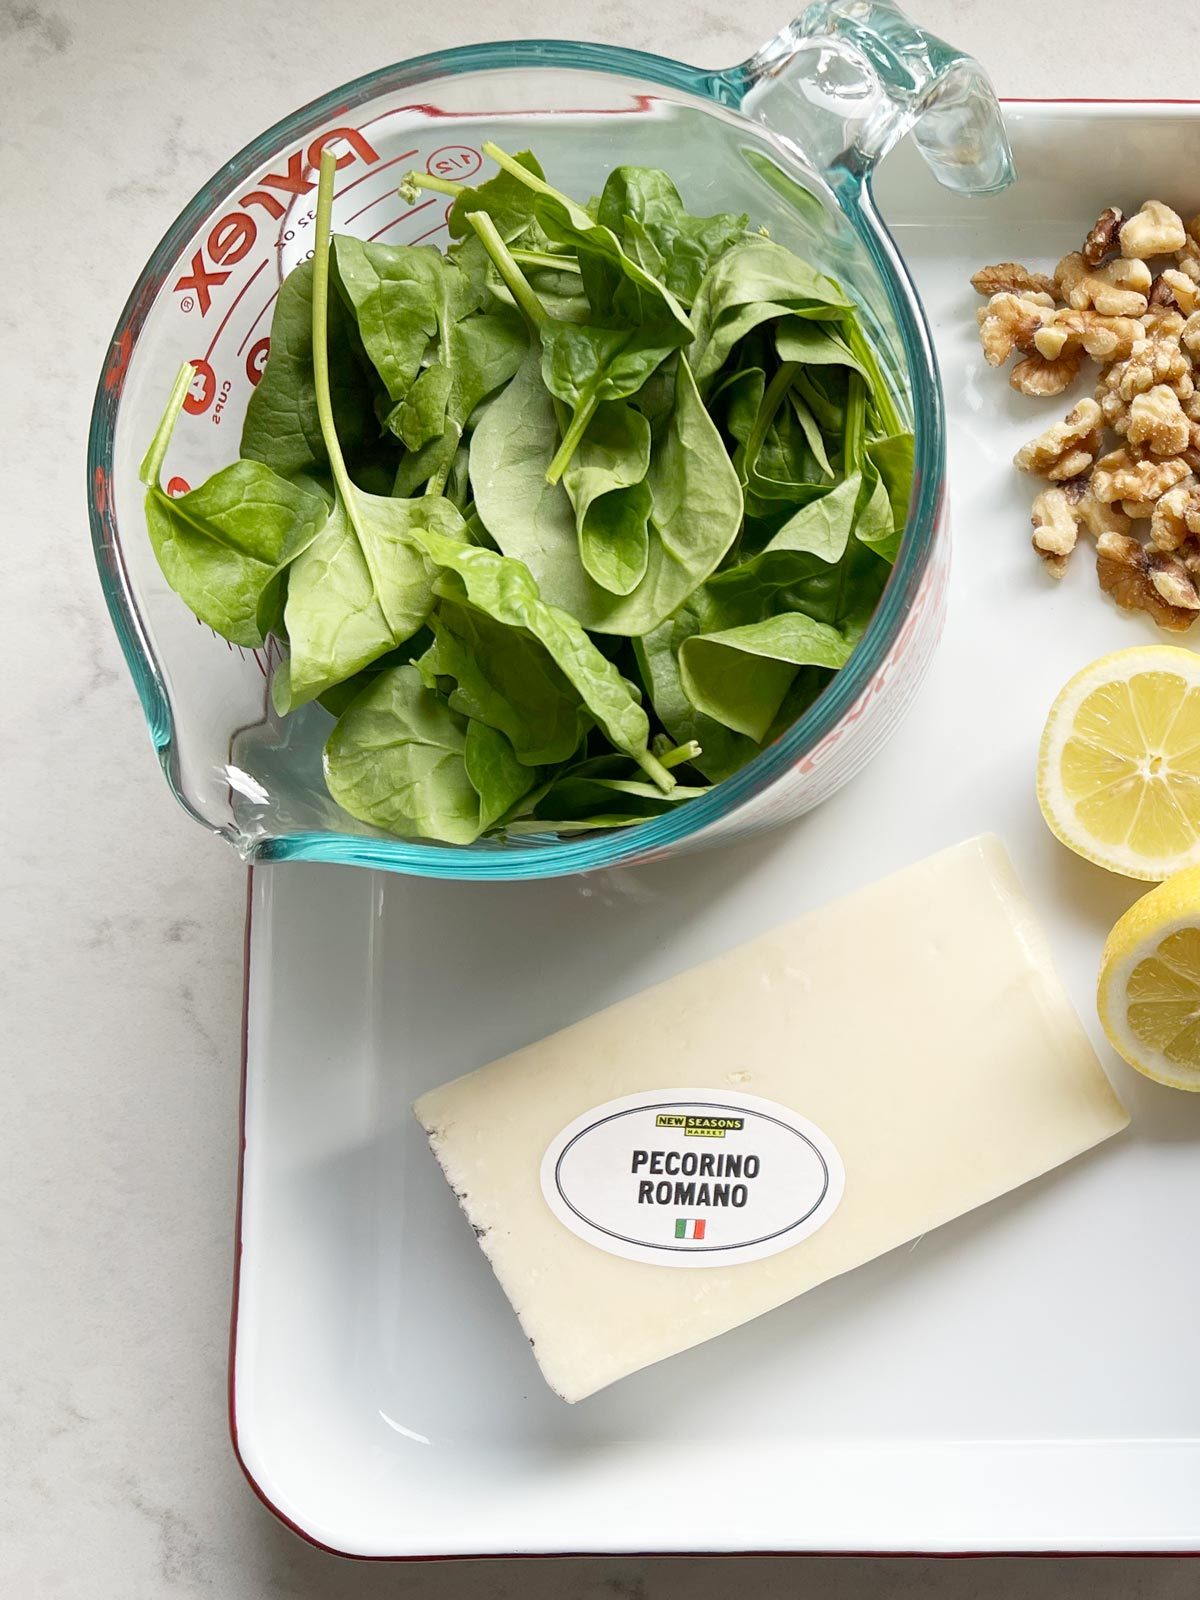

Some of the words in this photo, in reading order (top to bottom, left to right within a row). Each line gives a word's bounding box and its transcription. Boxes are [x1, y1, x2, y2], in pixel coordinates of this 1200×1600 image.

[659, 1116, 684, 1127] NEW
[688, 1118, 742, 1129] SEASONS
[688, 1129, 722, 1137] MARKET
[631, 1150, 760, 1179] PECORINO
[638, 1180, 749, 1208] ROMANO
